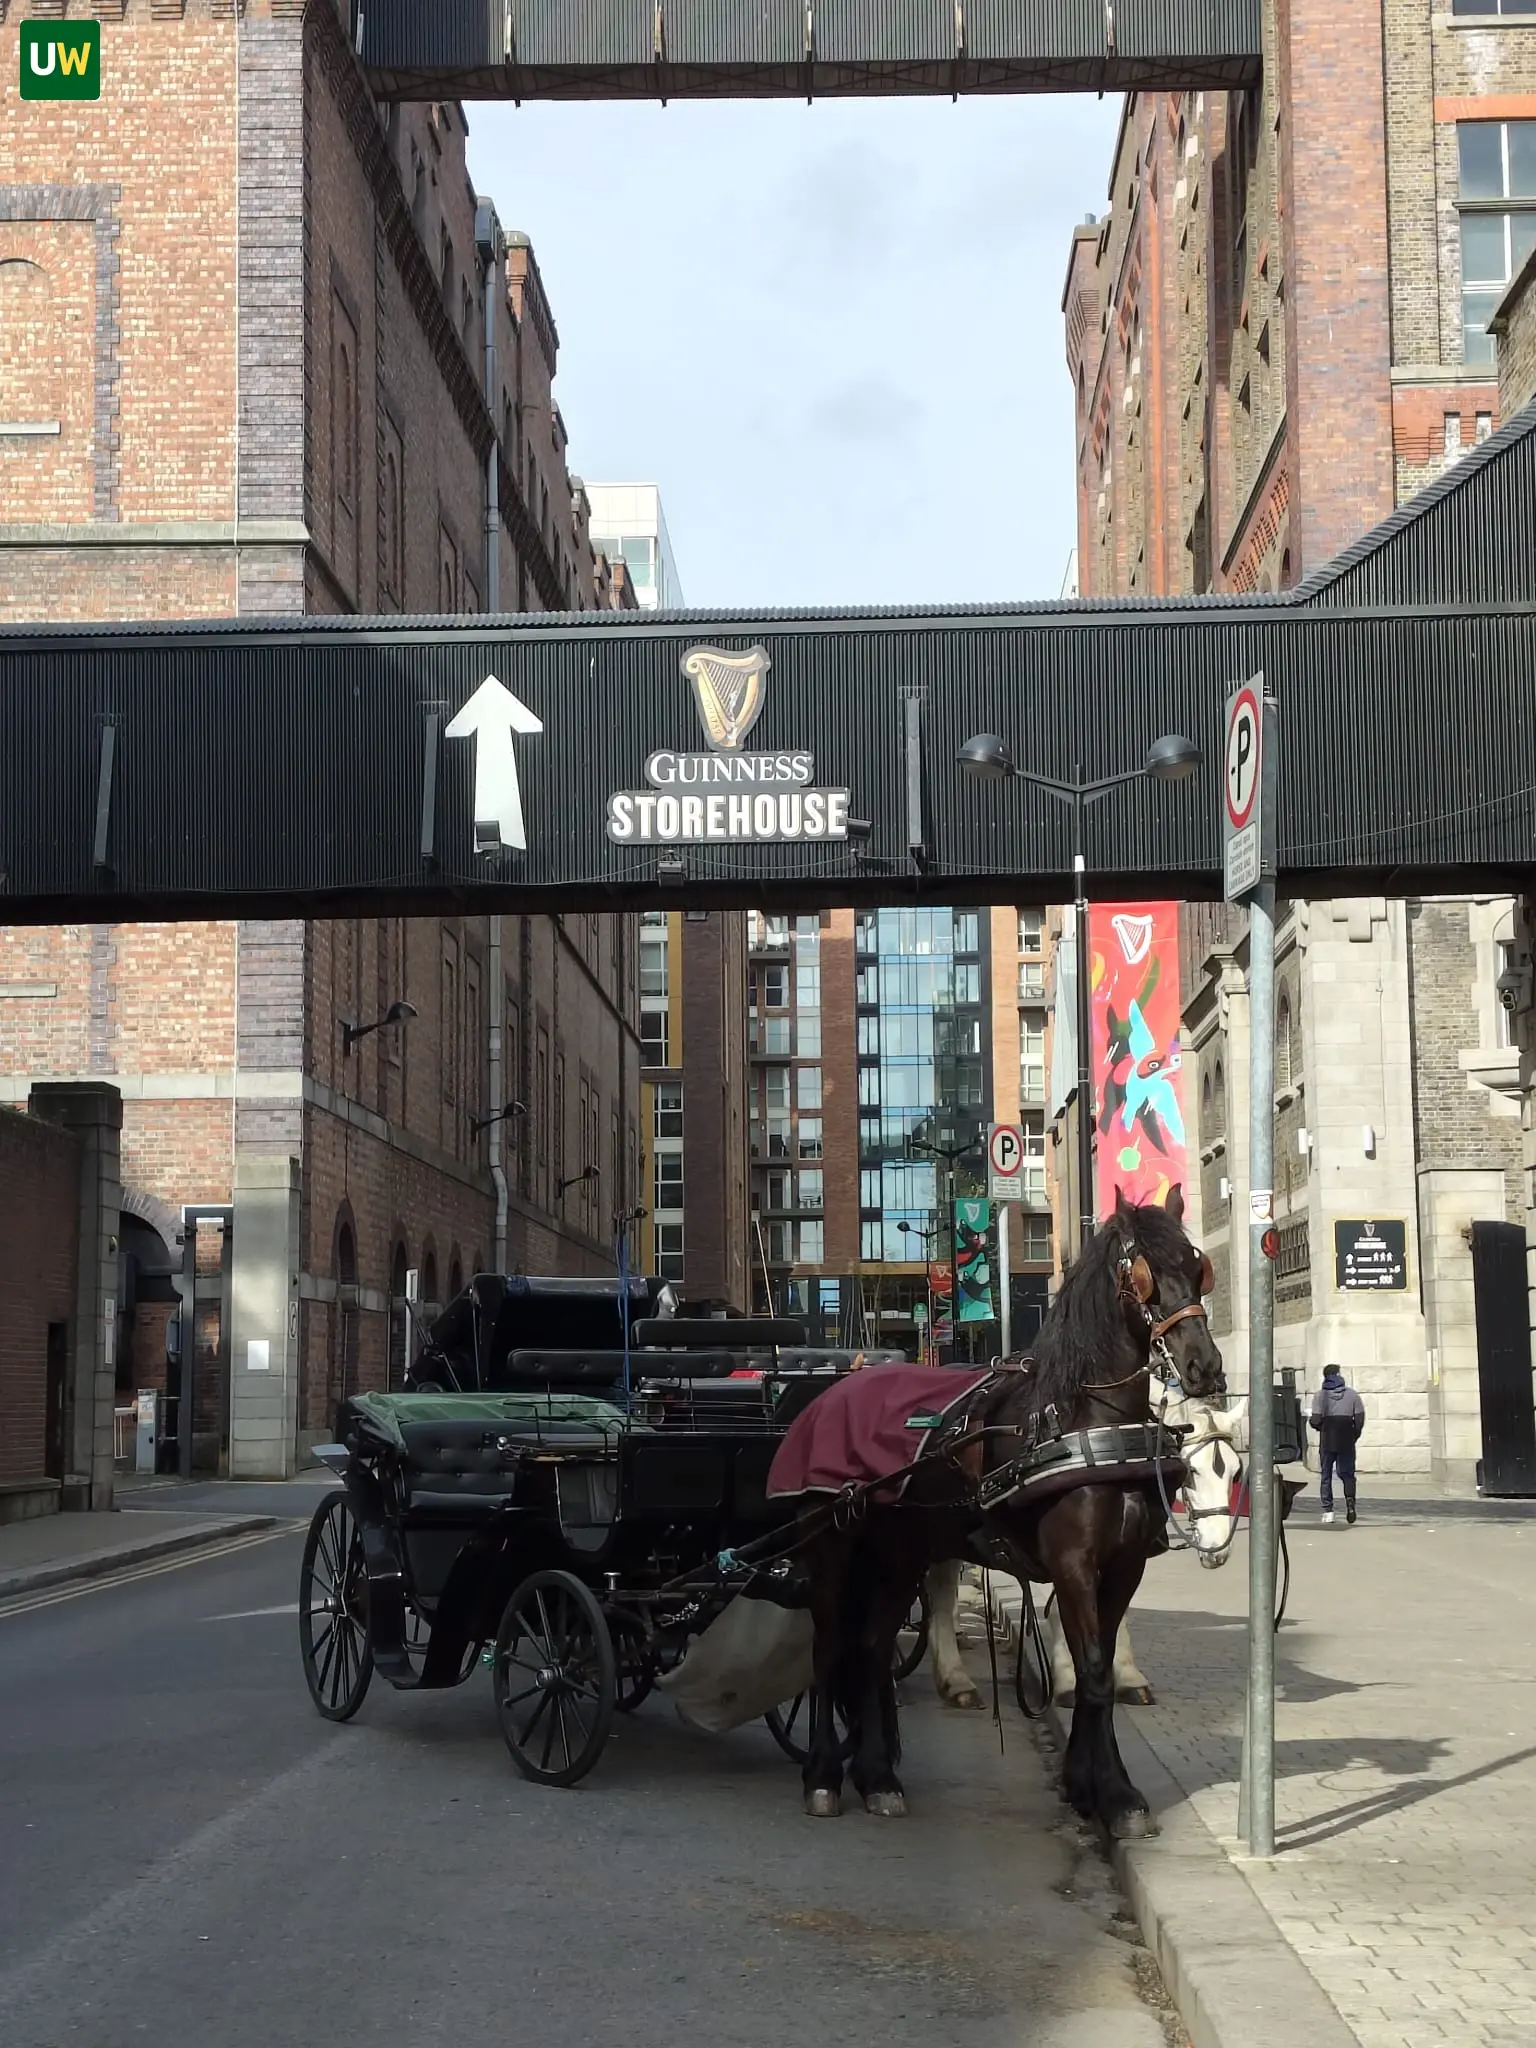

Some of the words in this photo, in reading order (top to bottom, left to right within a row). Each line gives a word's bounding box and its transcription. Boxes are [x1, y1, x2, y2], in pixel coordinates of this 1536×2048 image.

[1237, 715, 1251, 801] P
[611, 792, 847, 838] STOREHOUSE
[1001, 1135, 1014, 1166] P
